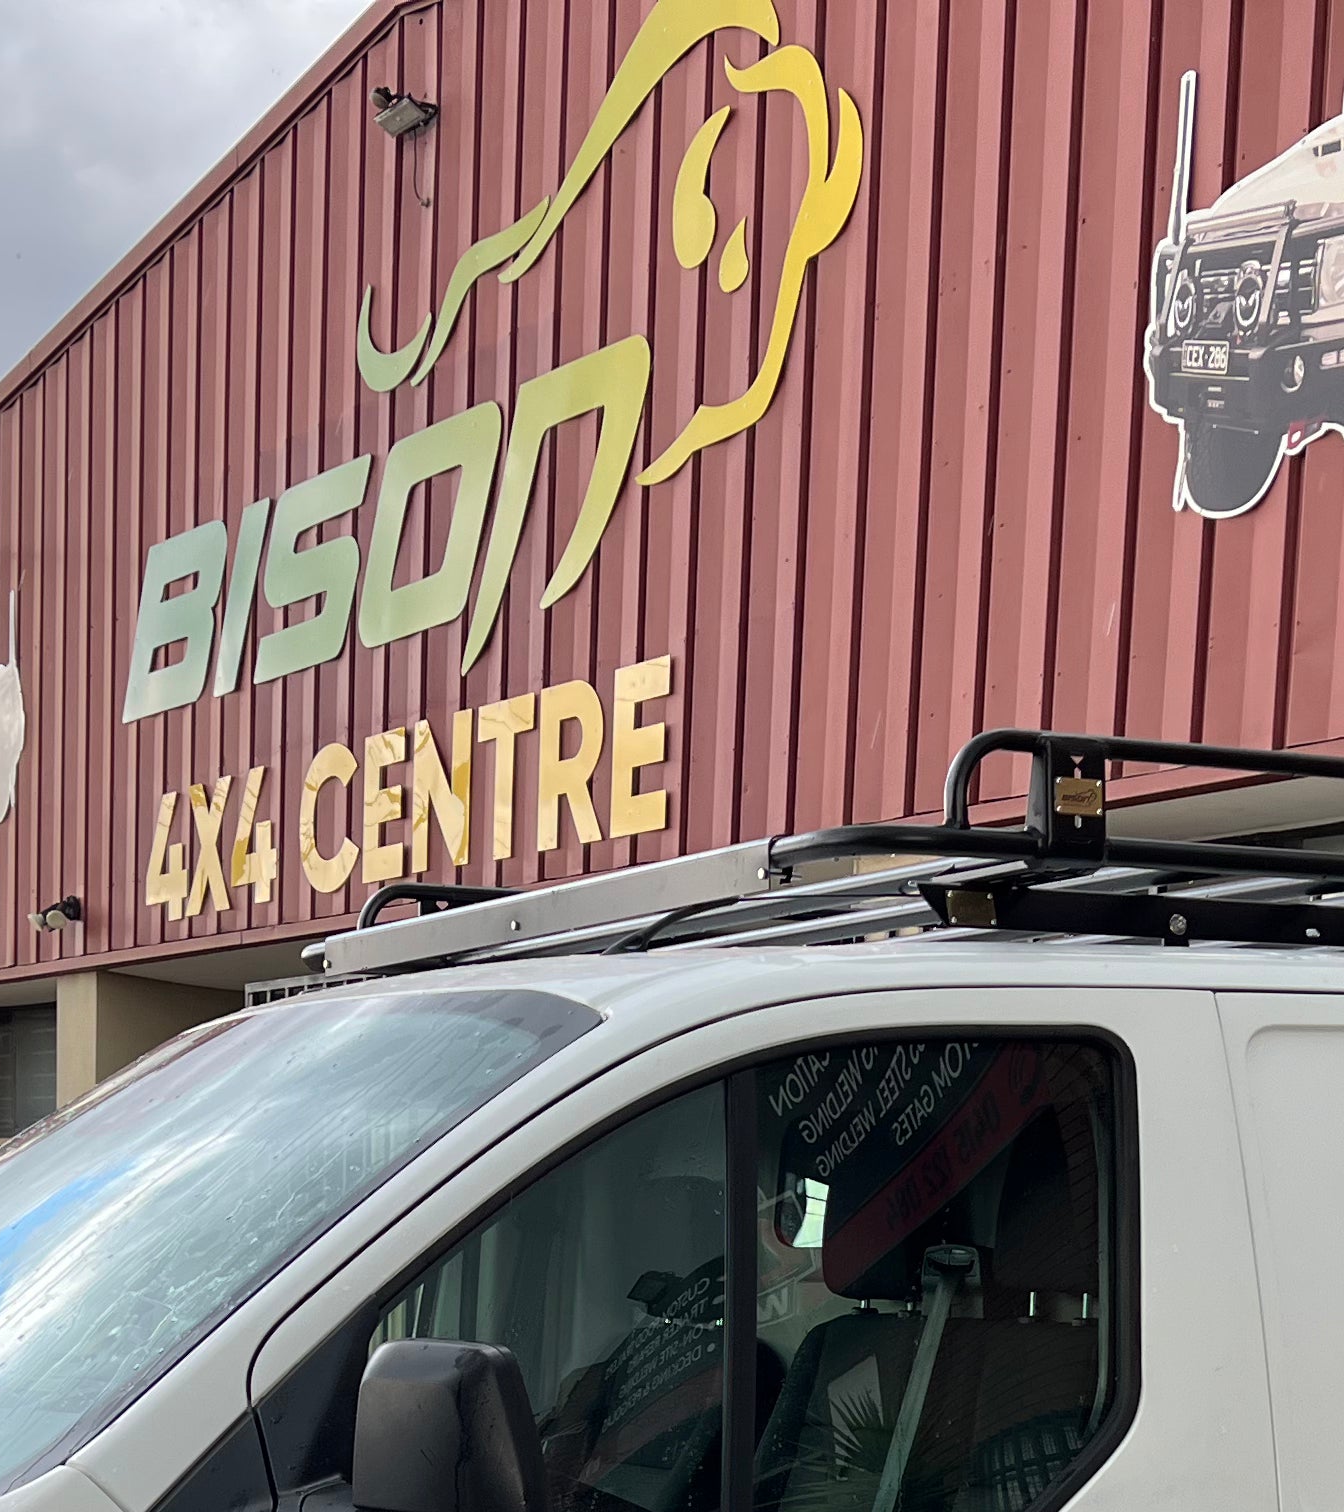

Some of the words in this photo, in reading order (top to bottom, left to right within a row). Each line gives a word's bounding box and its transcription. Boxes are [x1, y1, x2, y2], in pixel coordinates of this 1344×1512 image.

[122, 335, 650, 724] BISON
[145, 765, 278, 922] 4X4
[299, 655, 672, 893] CENTRE
